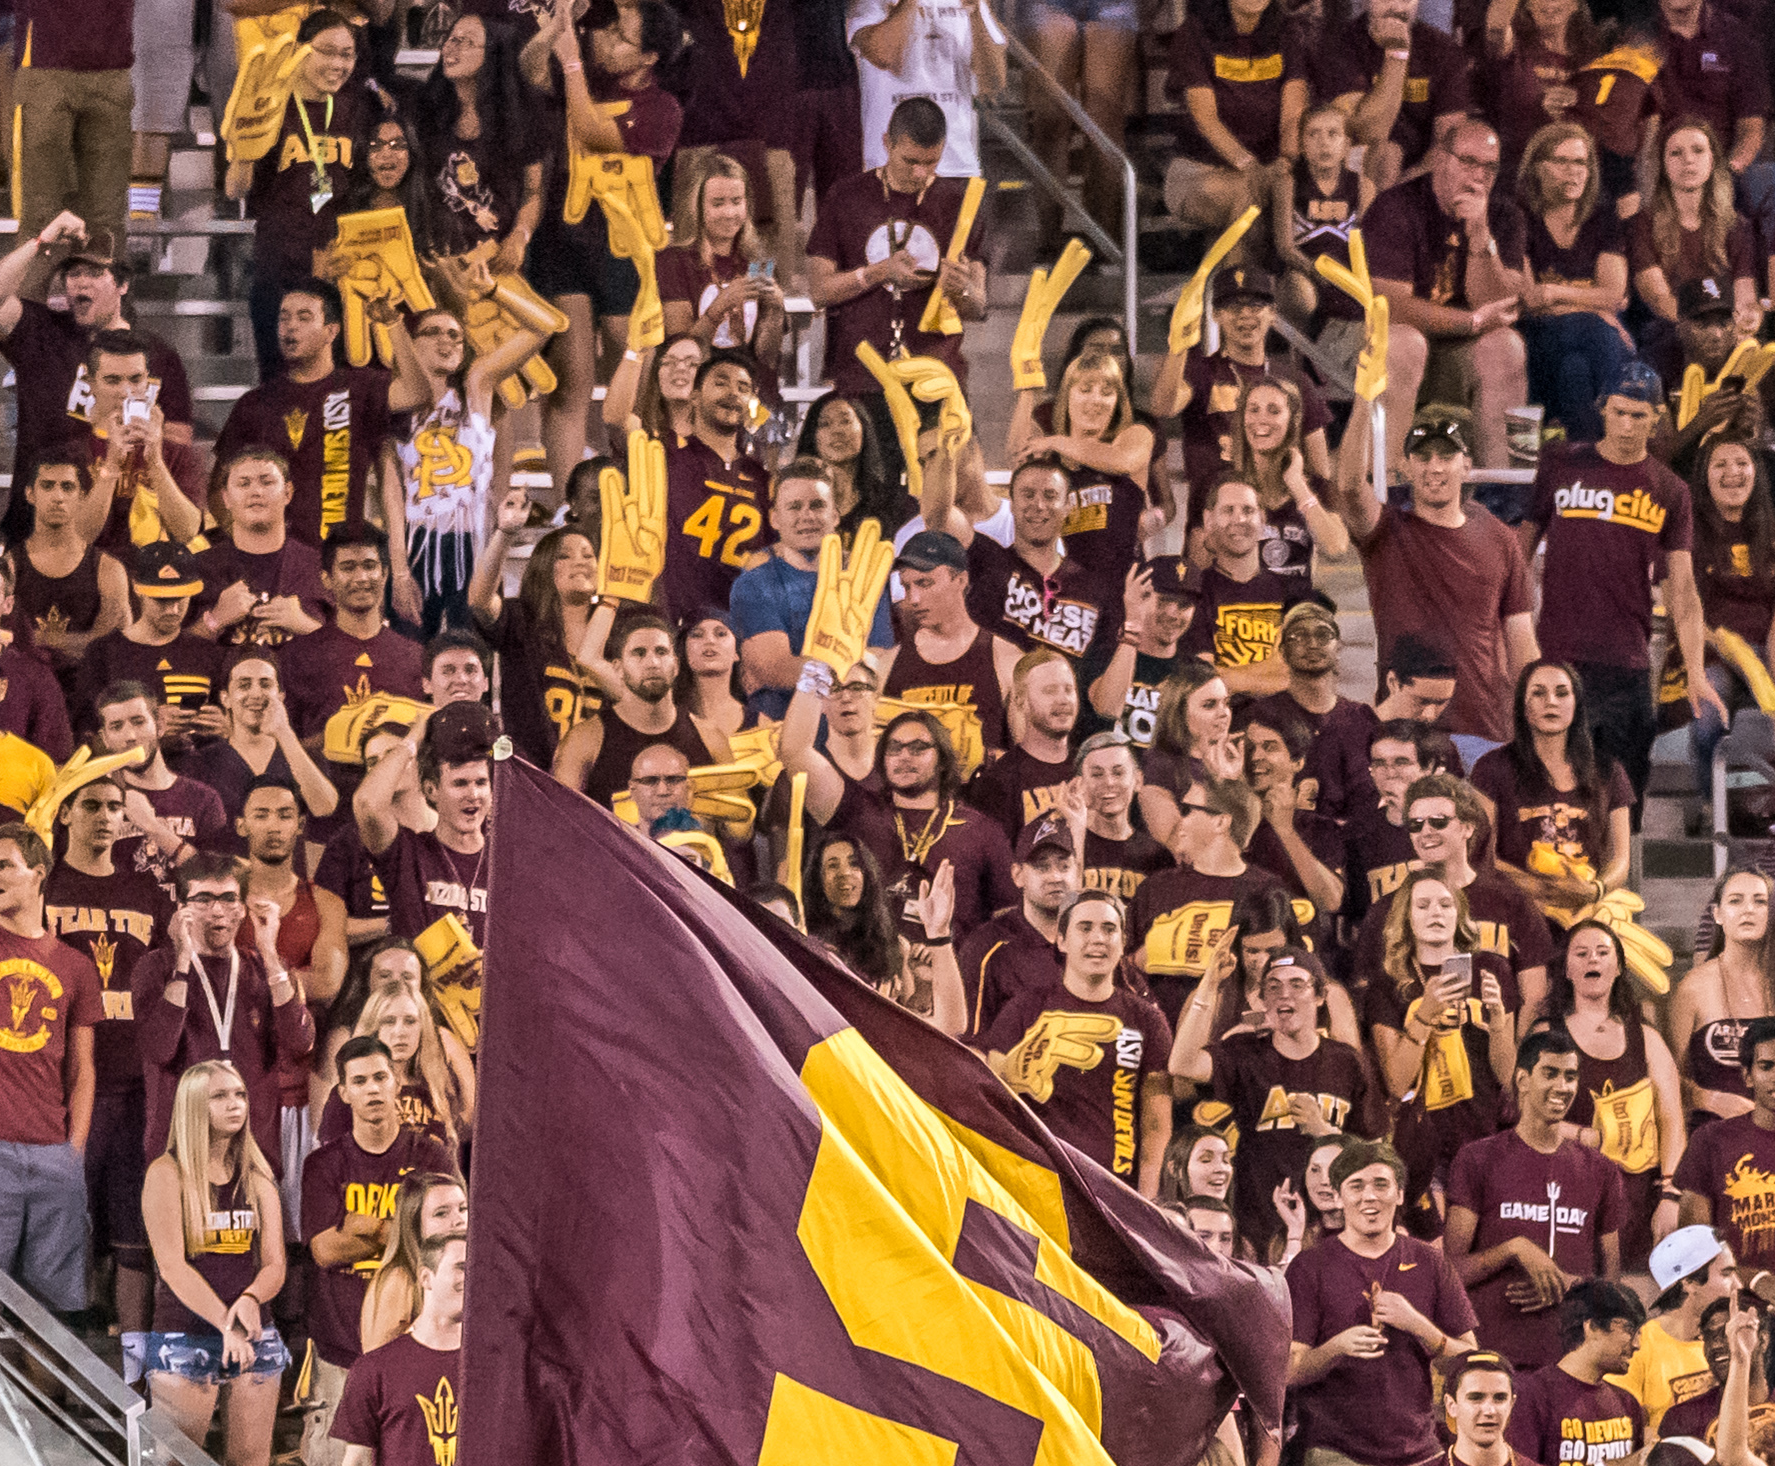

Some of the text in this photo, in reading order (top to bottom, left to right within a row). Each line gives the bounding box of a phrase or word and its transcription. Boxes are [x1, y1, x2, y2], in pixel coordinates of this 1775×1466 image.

[682, 494, 762, 567] 42
[1084, 867, 1145, 899] RIZO
[1185, 913, 1209, 964] Devils!
[1111, 1027, 1143, 1176] ASU SUN DEVILS
[345, 1182, 396, 1220] ORK
[1499, 1201, 1589, 1227] GAME DAY
[1560, 1415, 1633, 1443] GO DEVILS
[1558, 1440, 1585, 1462] GO
